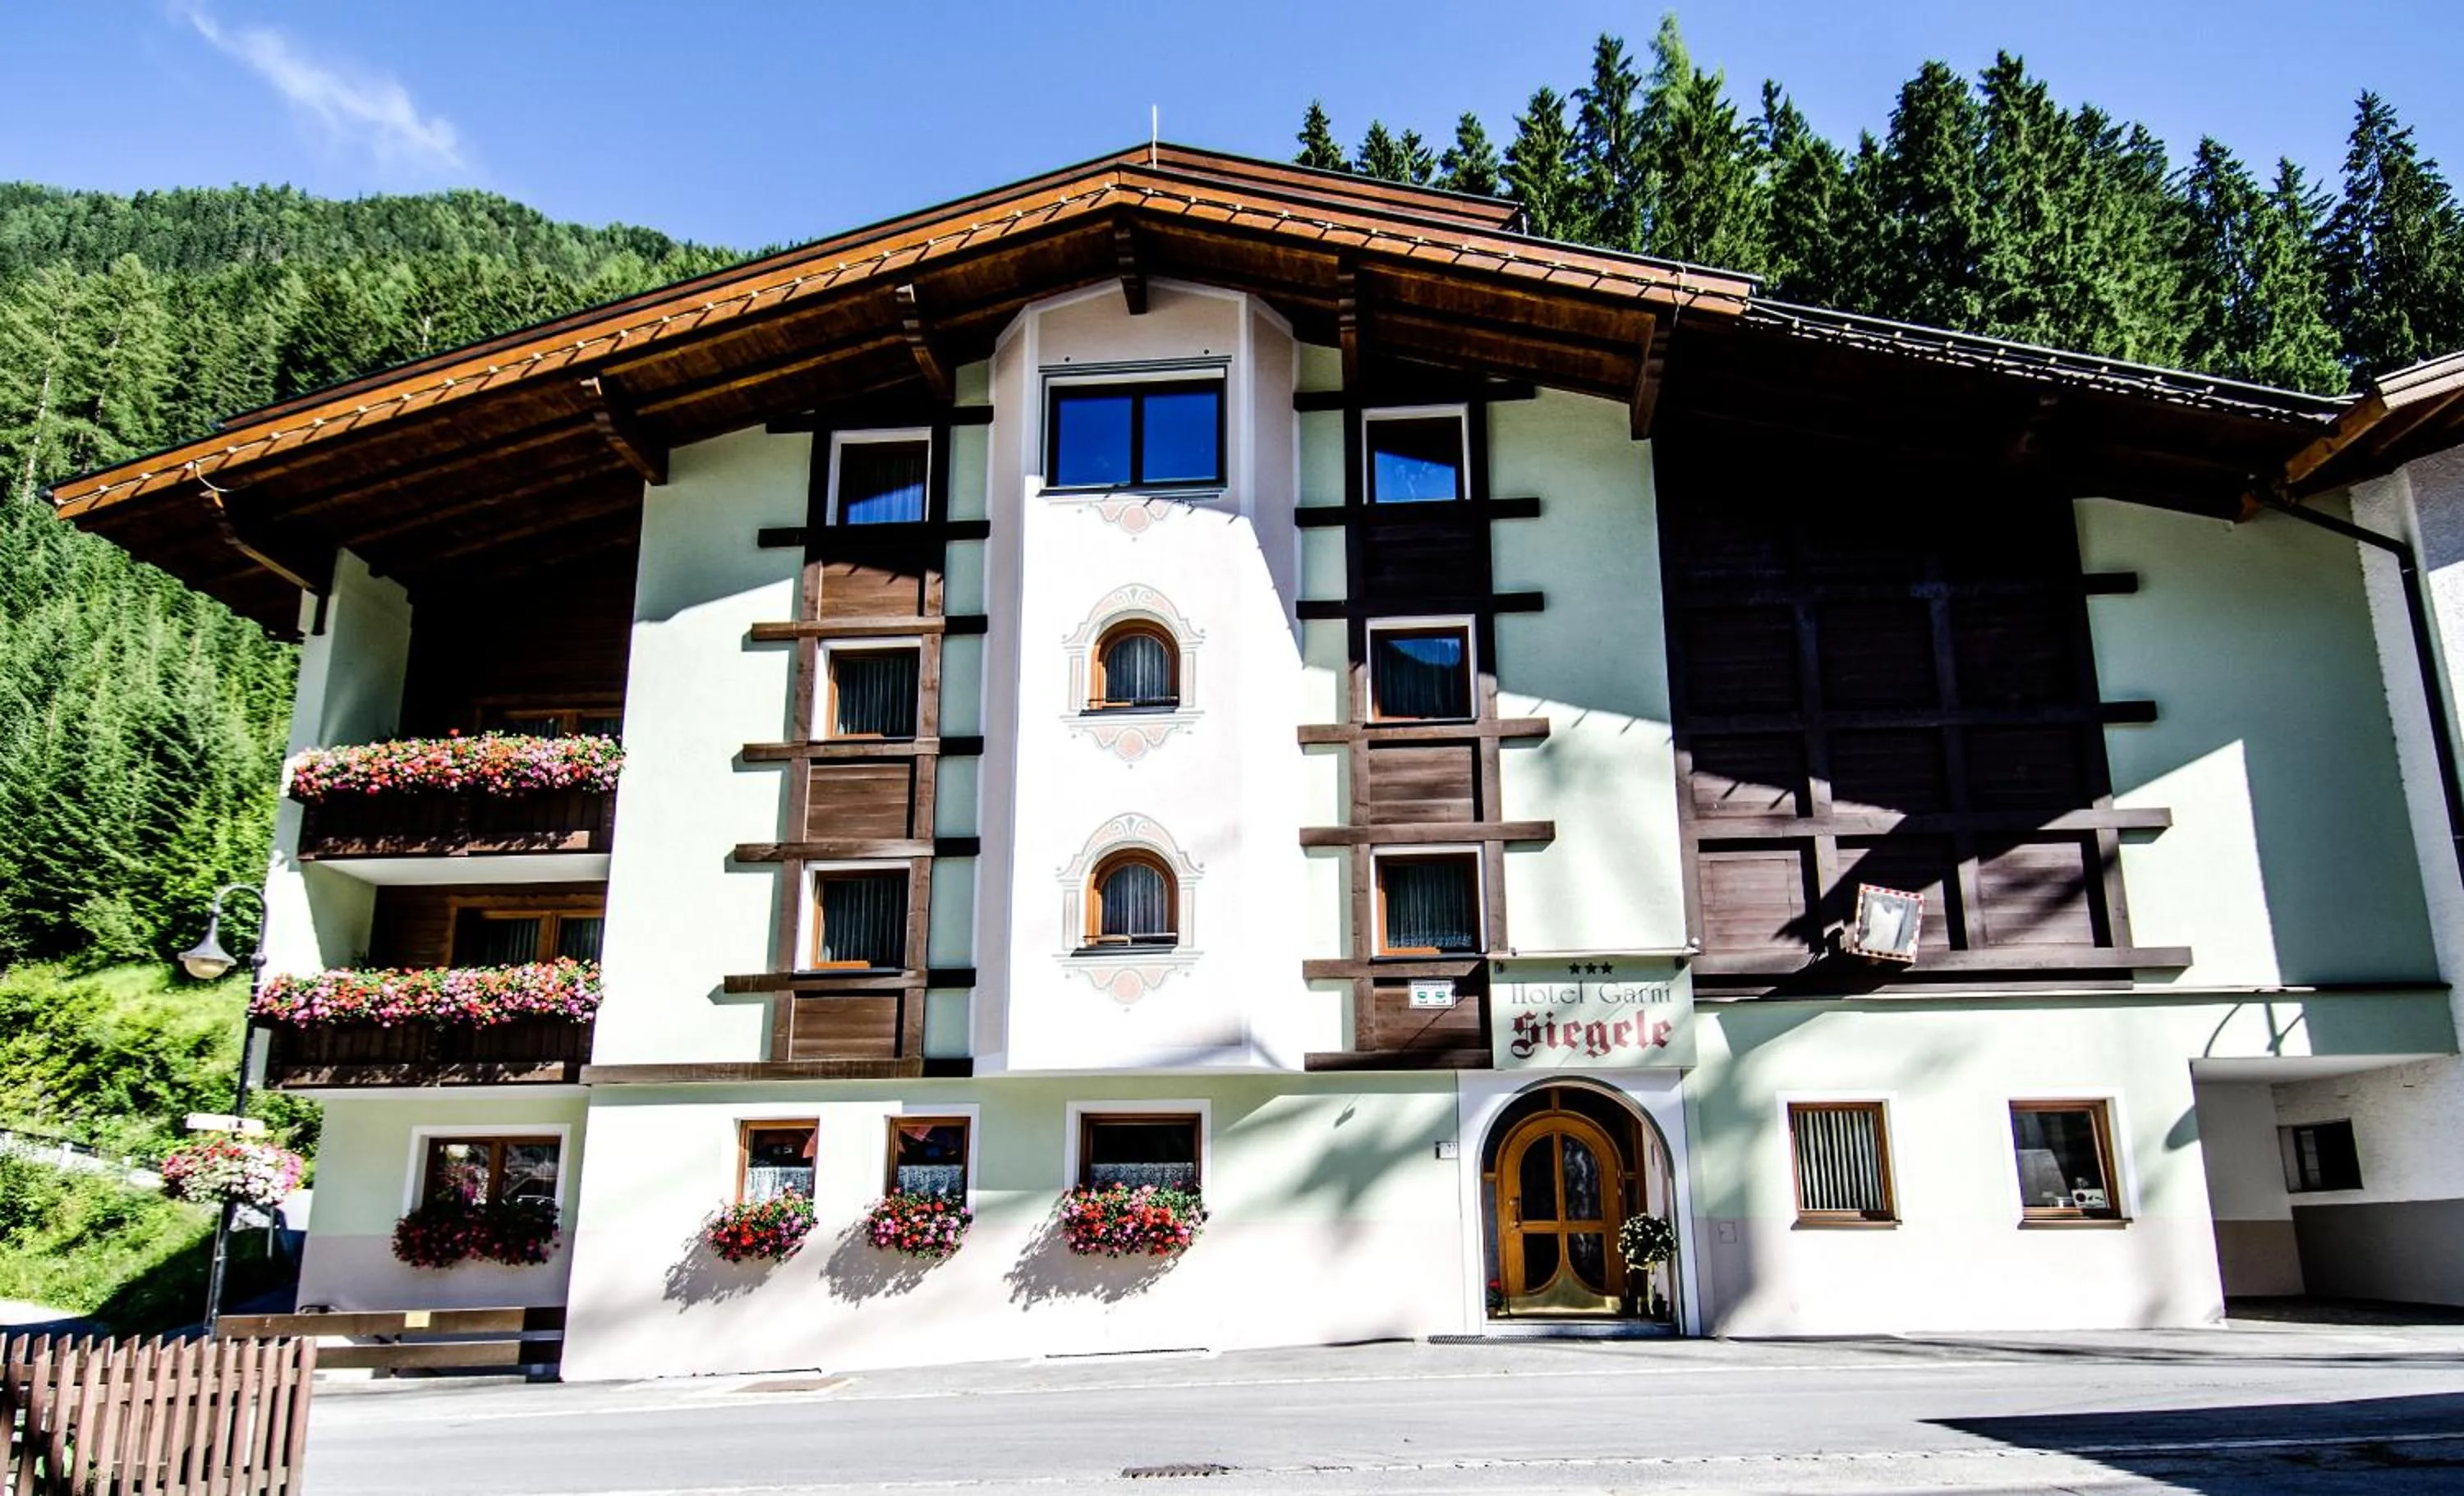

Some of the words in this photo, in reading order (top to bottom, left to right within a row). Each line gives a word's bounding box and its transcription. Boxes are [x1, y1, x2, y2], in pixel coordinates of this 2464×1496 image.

[1510, 980, 1584, 1004] Hotel
[1598, 982, 1671, 1004] Garni
[1510, 1010, 1672, 1059] Siegele
